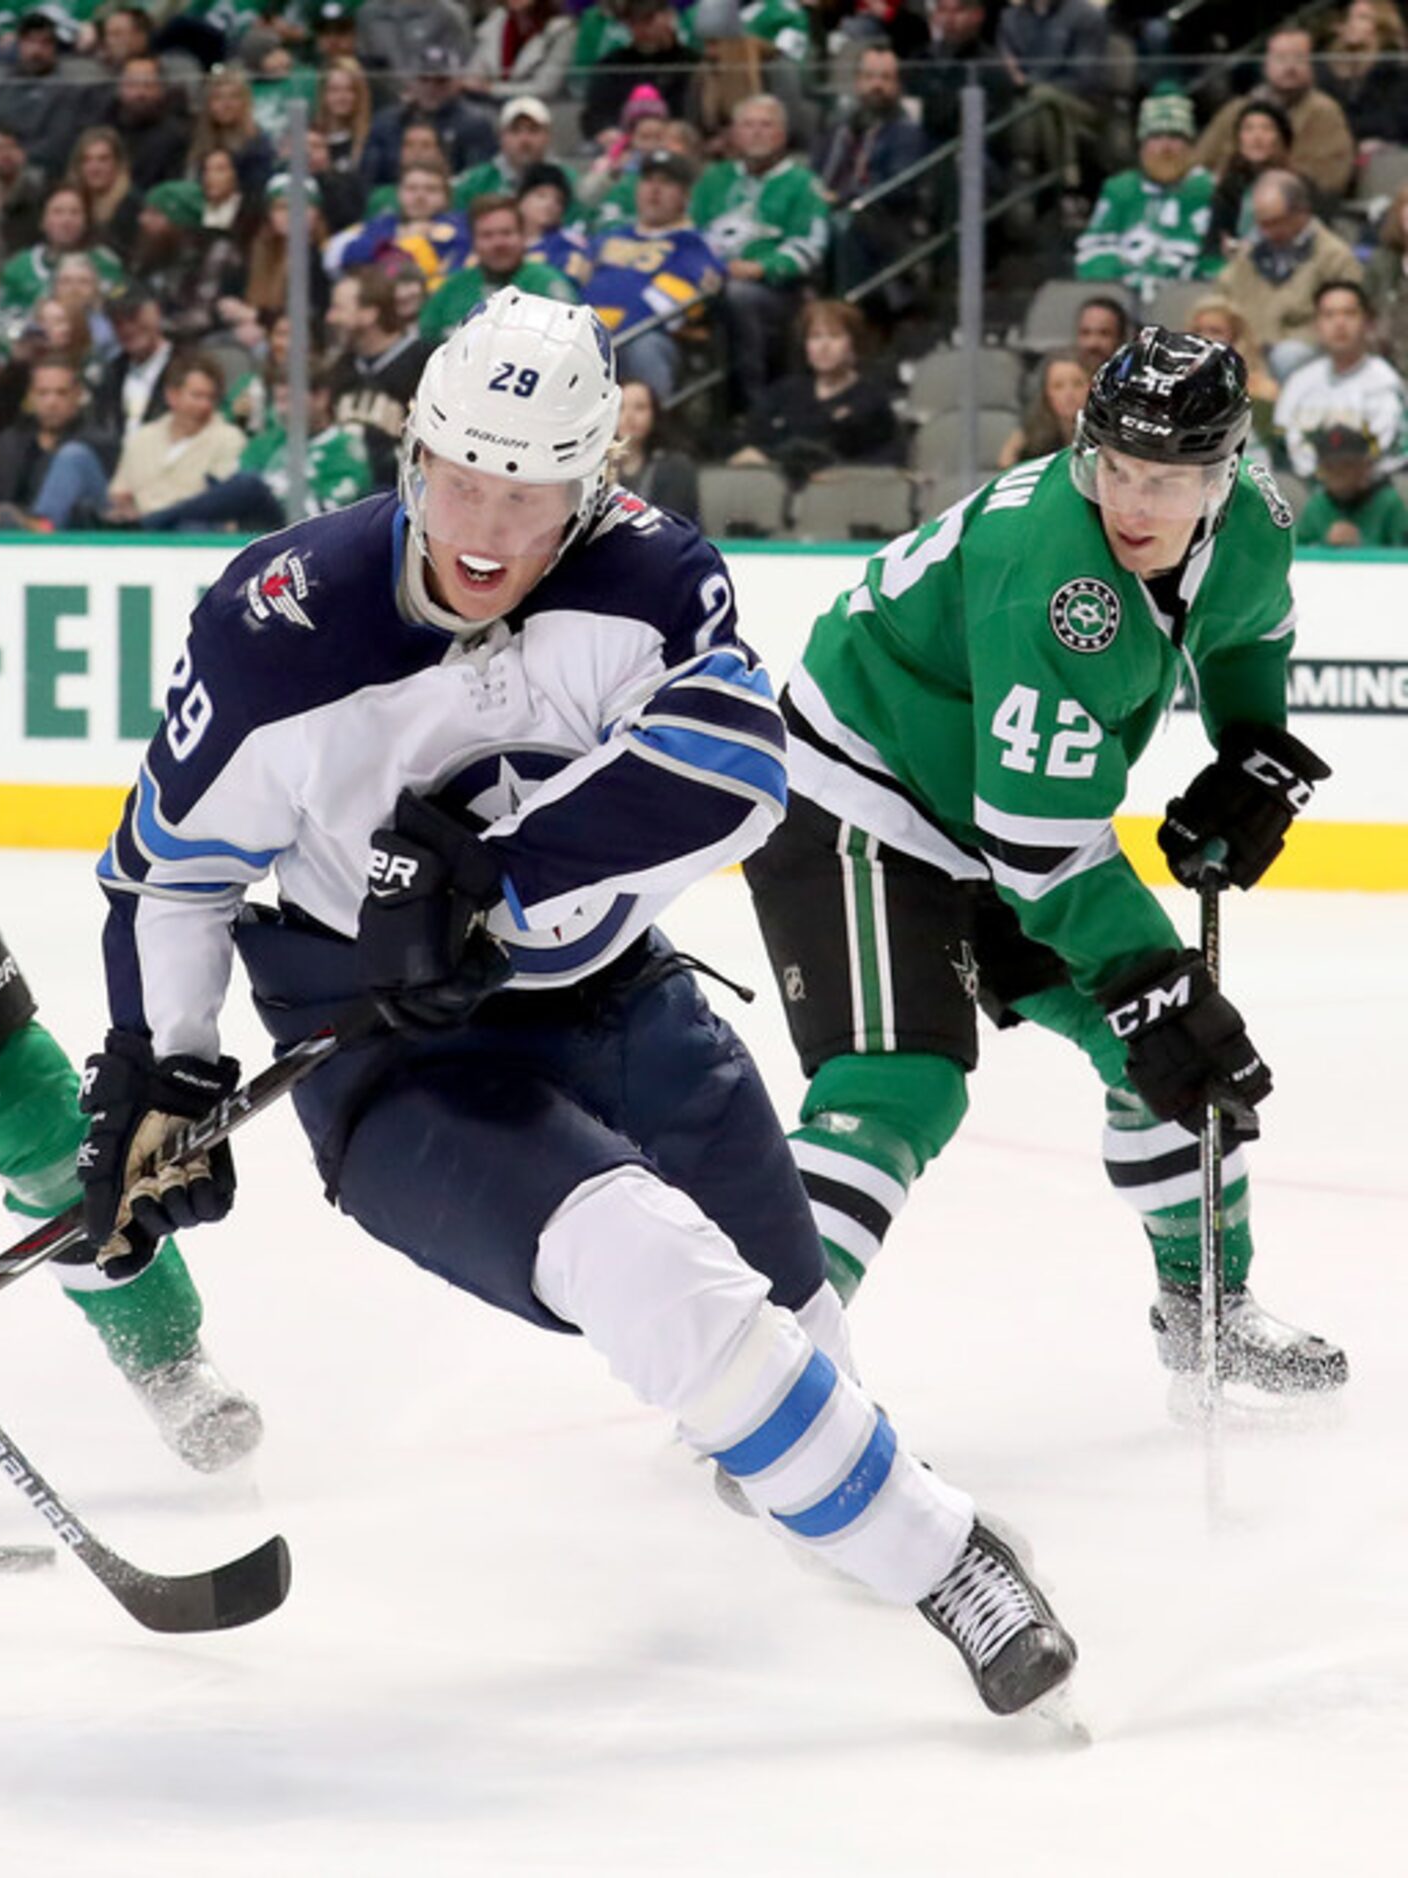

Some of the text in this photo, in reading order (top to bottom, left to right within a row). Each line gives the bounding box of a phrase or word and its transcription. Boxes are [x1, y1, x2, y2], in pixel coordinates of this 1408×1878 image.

[487, 361, 540, 399] 29
[1120, 414, 1172, 437] CCM
[990, 683, 1104, 779] 42
